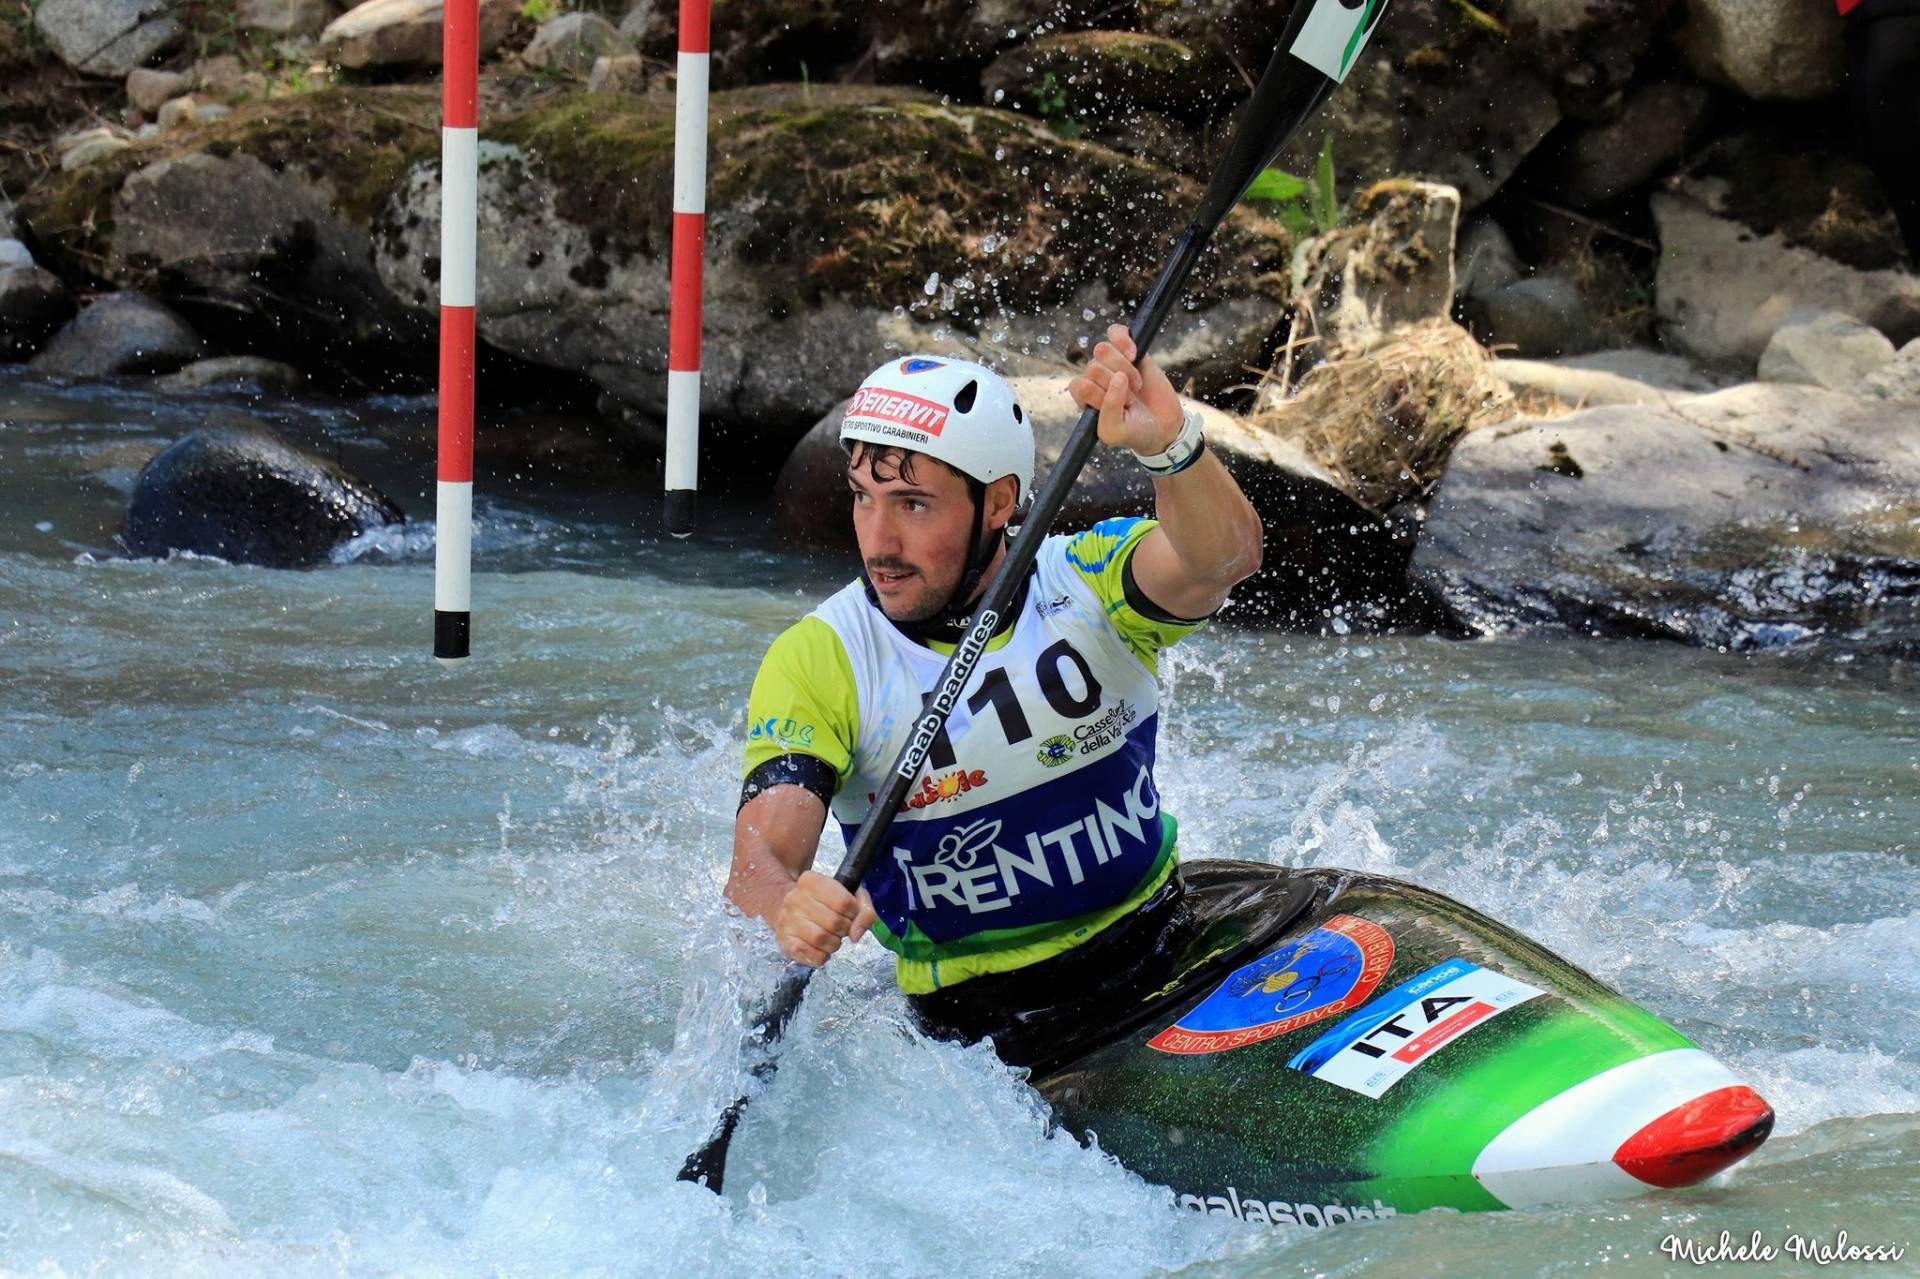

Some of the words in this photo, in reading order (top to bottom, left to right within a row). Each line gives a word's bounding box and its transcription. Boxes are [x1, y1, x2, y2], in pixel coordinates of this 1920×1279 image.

[882, 425, 929, 444] CARABINIERI
[899, 715, 941, 779] raab
[933, 610, 999, 715] paddles
[1080, 735, 1112, 755] della
[893, 764, 1160, 914] TRENTINO
[1161, 1033, 1228, 1051] CENTRO
[1228, 1001, 1347, 1047] SPORTIVO
[1351, 996, 1474, 1059] ITA
